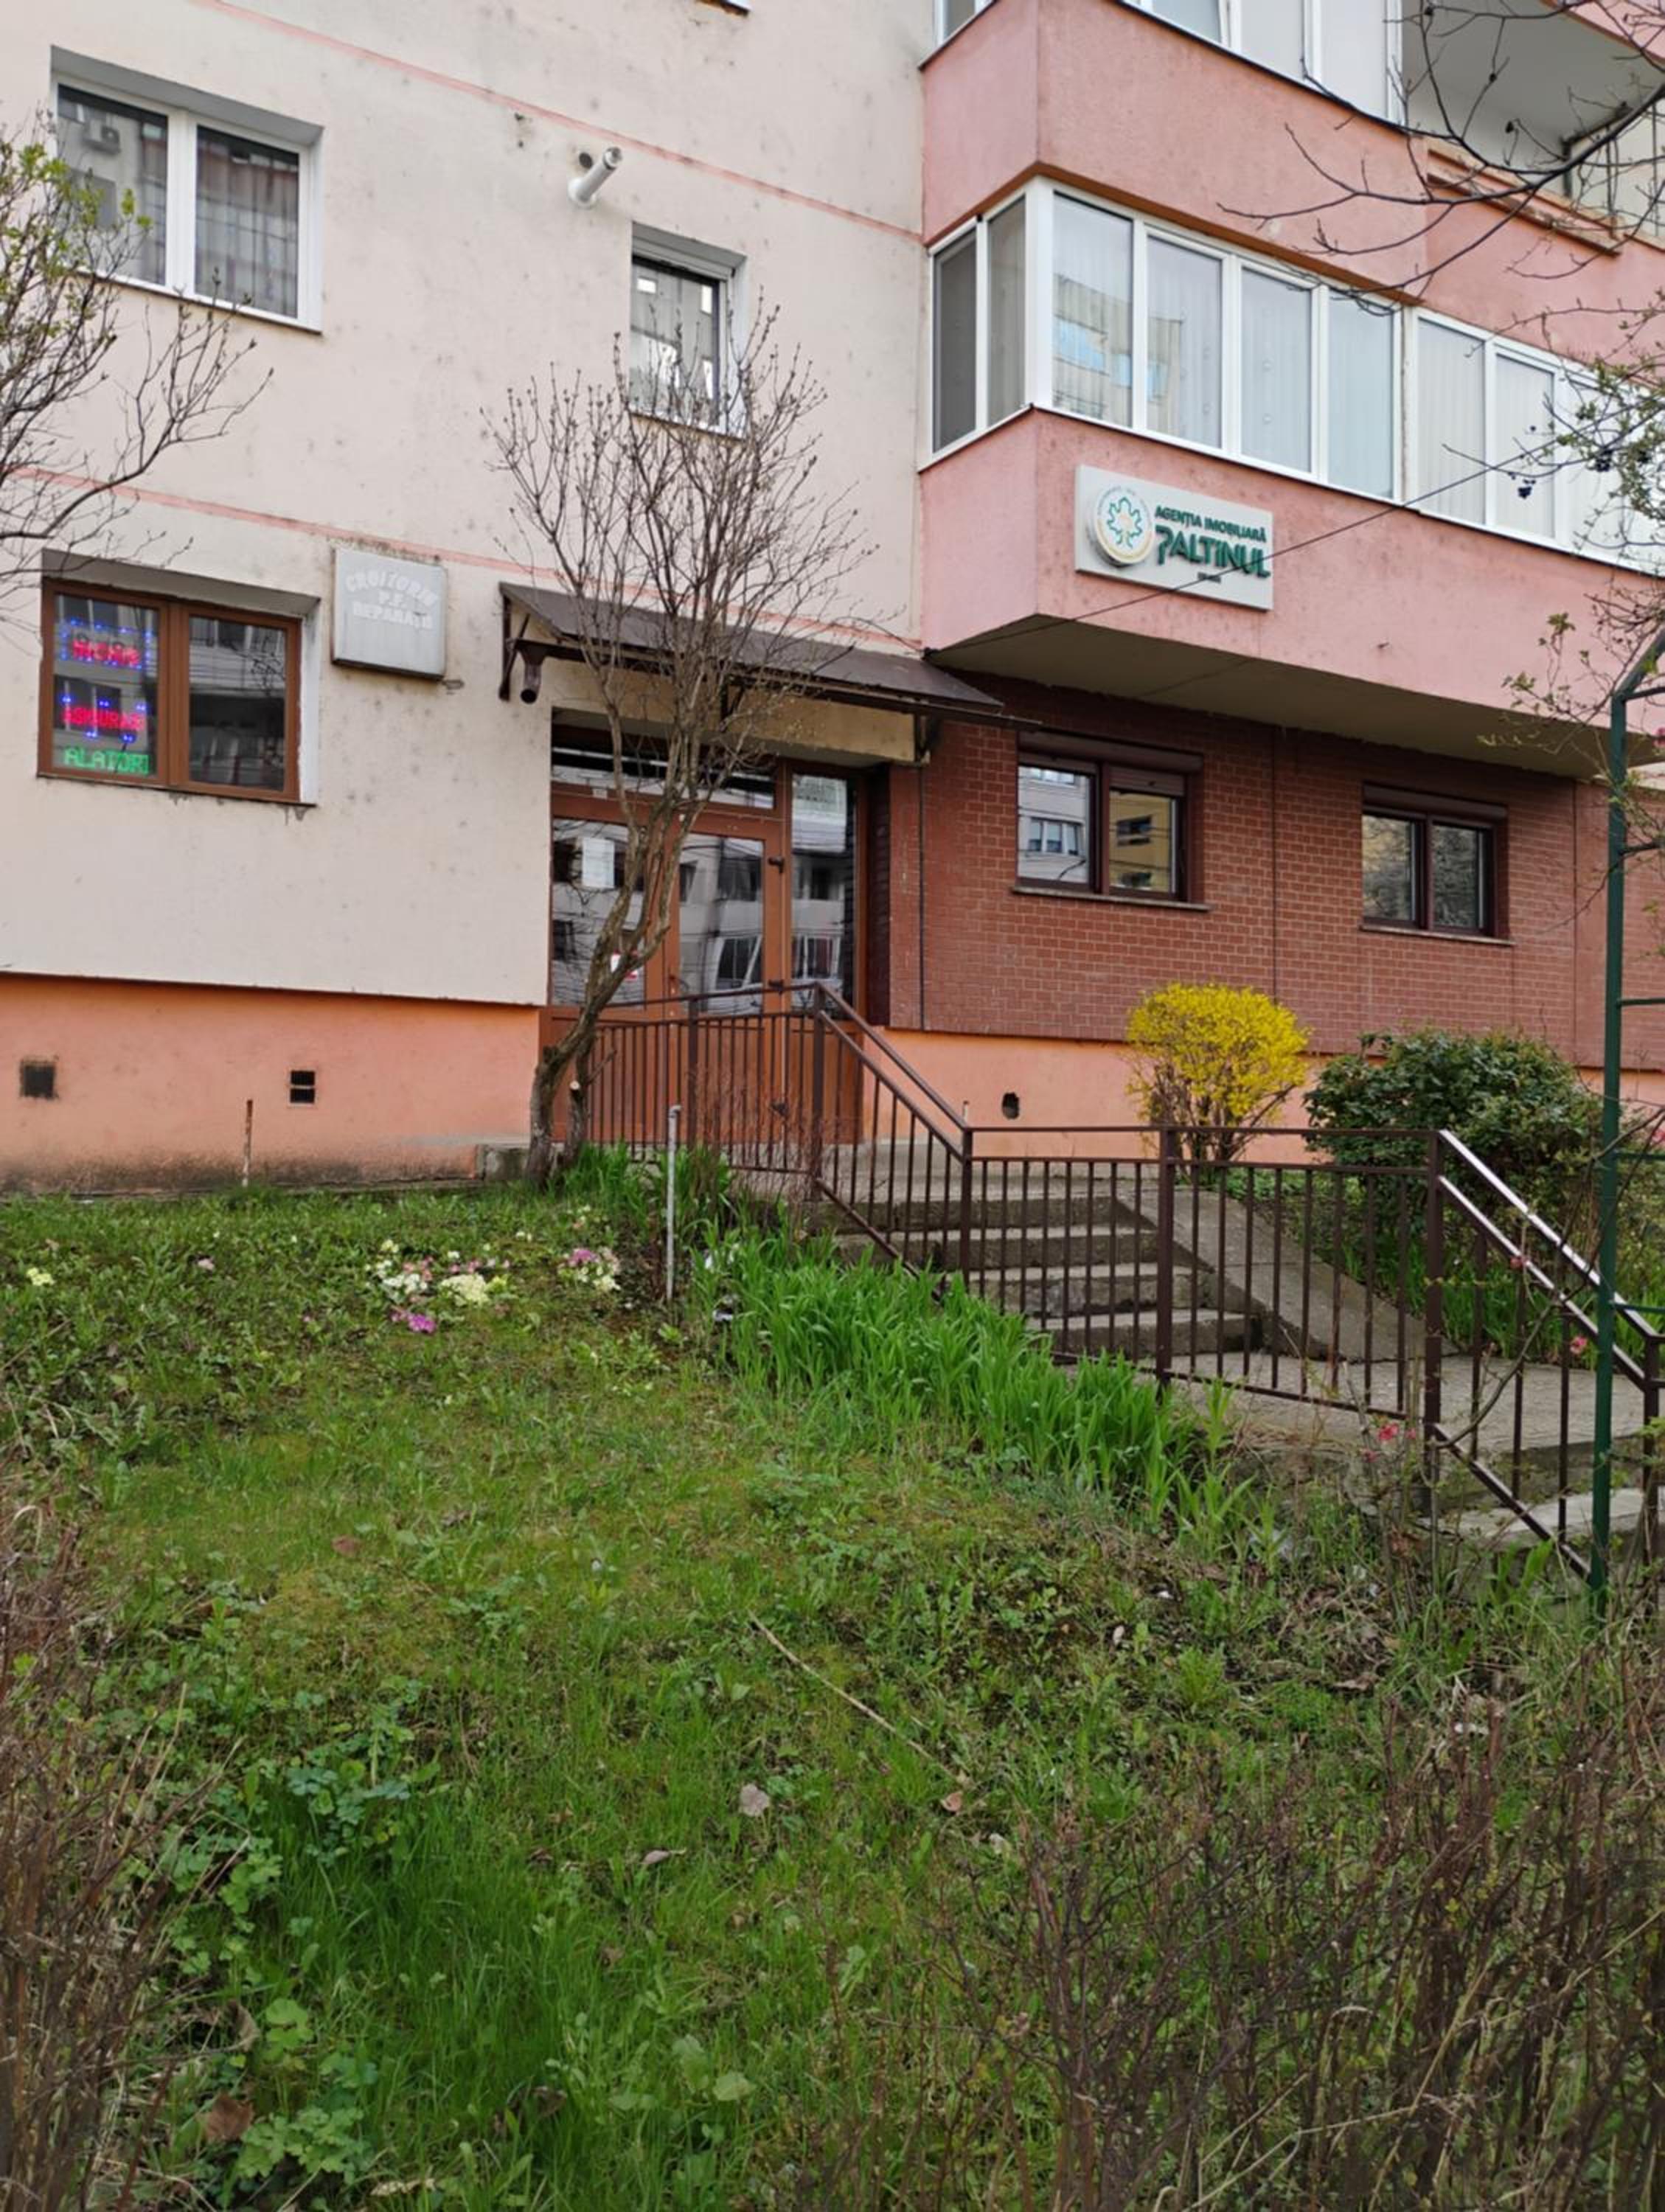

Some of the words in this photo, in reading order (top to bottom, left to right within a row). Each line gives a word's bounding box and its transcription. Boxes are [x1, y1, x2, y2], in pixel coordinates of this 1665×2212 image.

[1155, 505, 1202, 527] AGENȚIA
[1205, 517, 1267, 543] IMOBILIARĂ
[1155, 524, 1271, 578] PALTINUL
